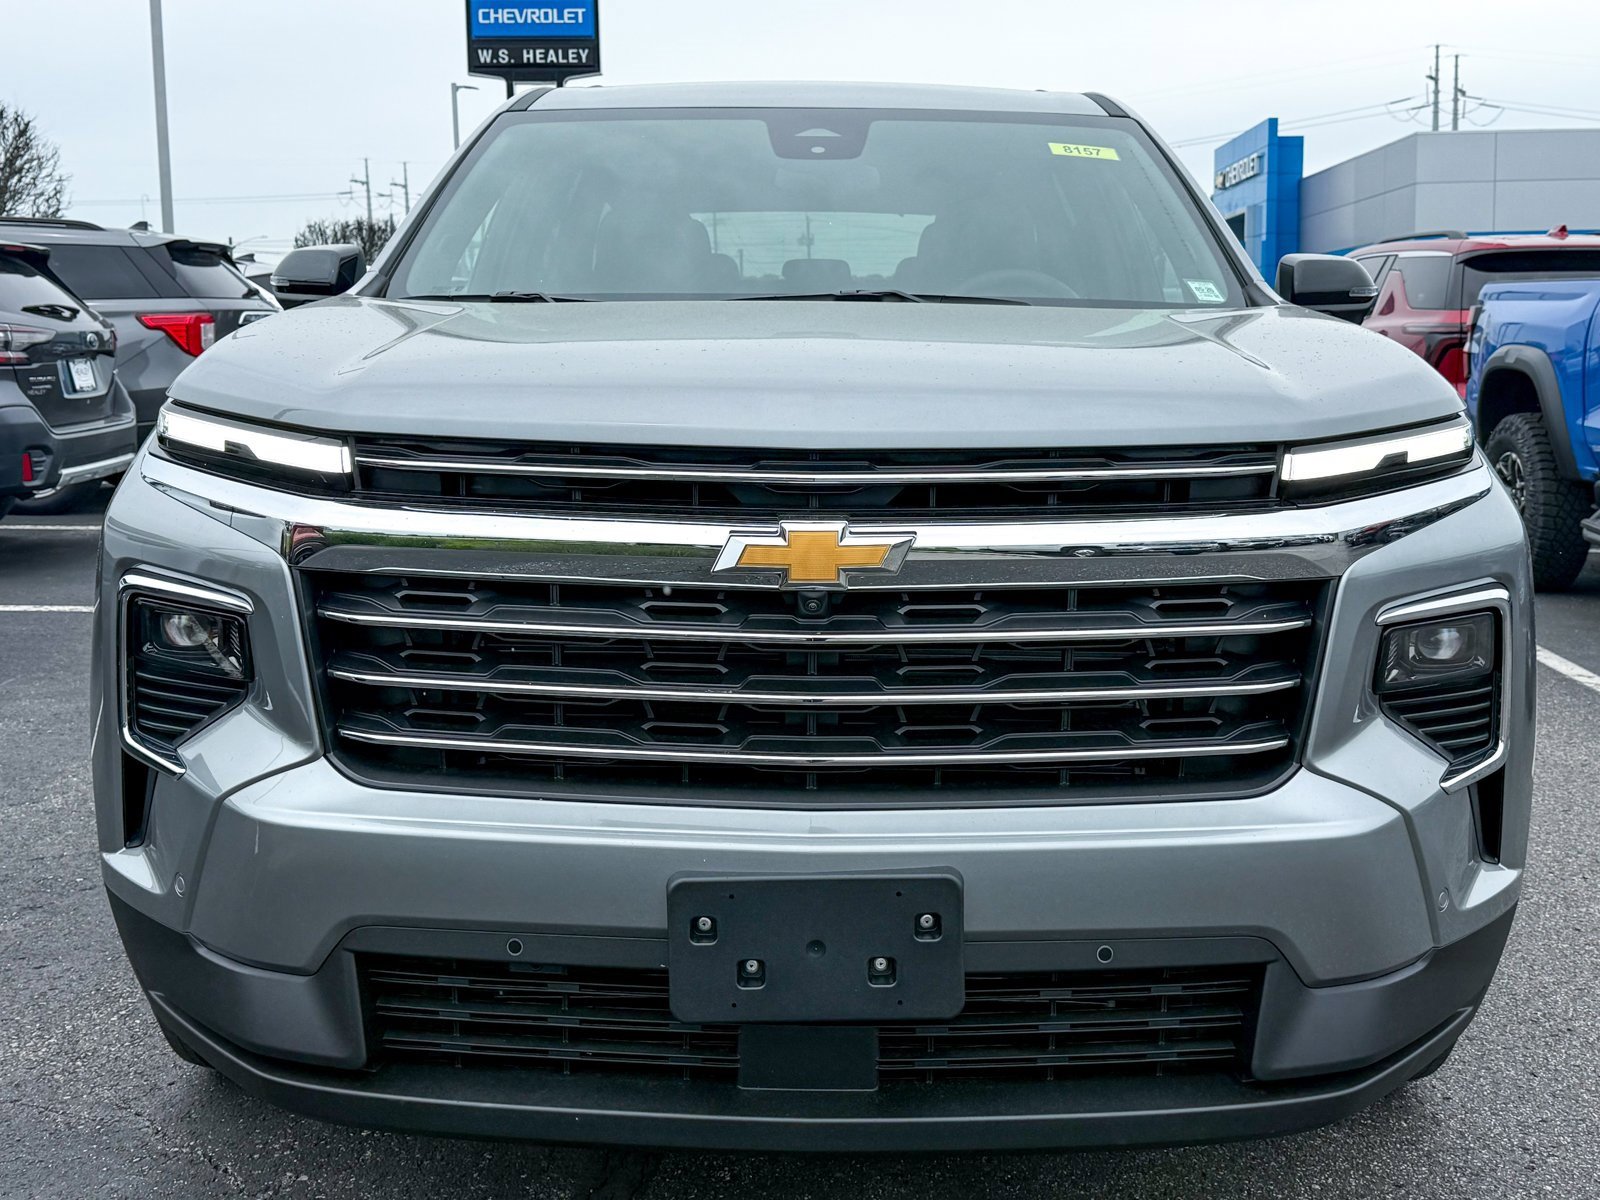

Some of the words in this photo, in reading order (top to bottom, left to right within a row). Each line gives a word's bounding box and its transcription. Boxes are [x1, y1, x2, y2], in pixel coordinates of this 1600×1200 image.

[477, 8, 586, 24] CHEVROLET
[477, 49, 515, 63] W.S.
[522, 49, 589, 63] HEALEY
[1062, 145, 1101, 156] 8157
